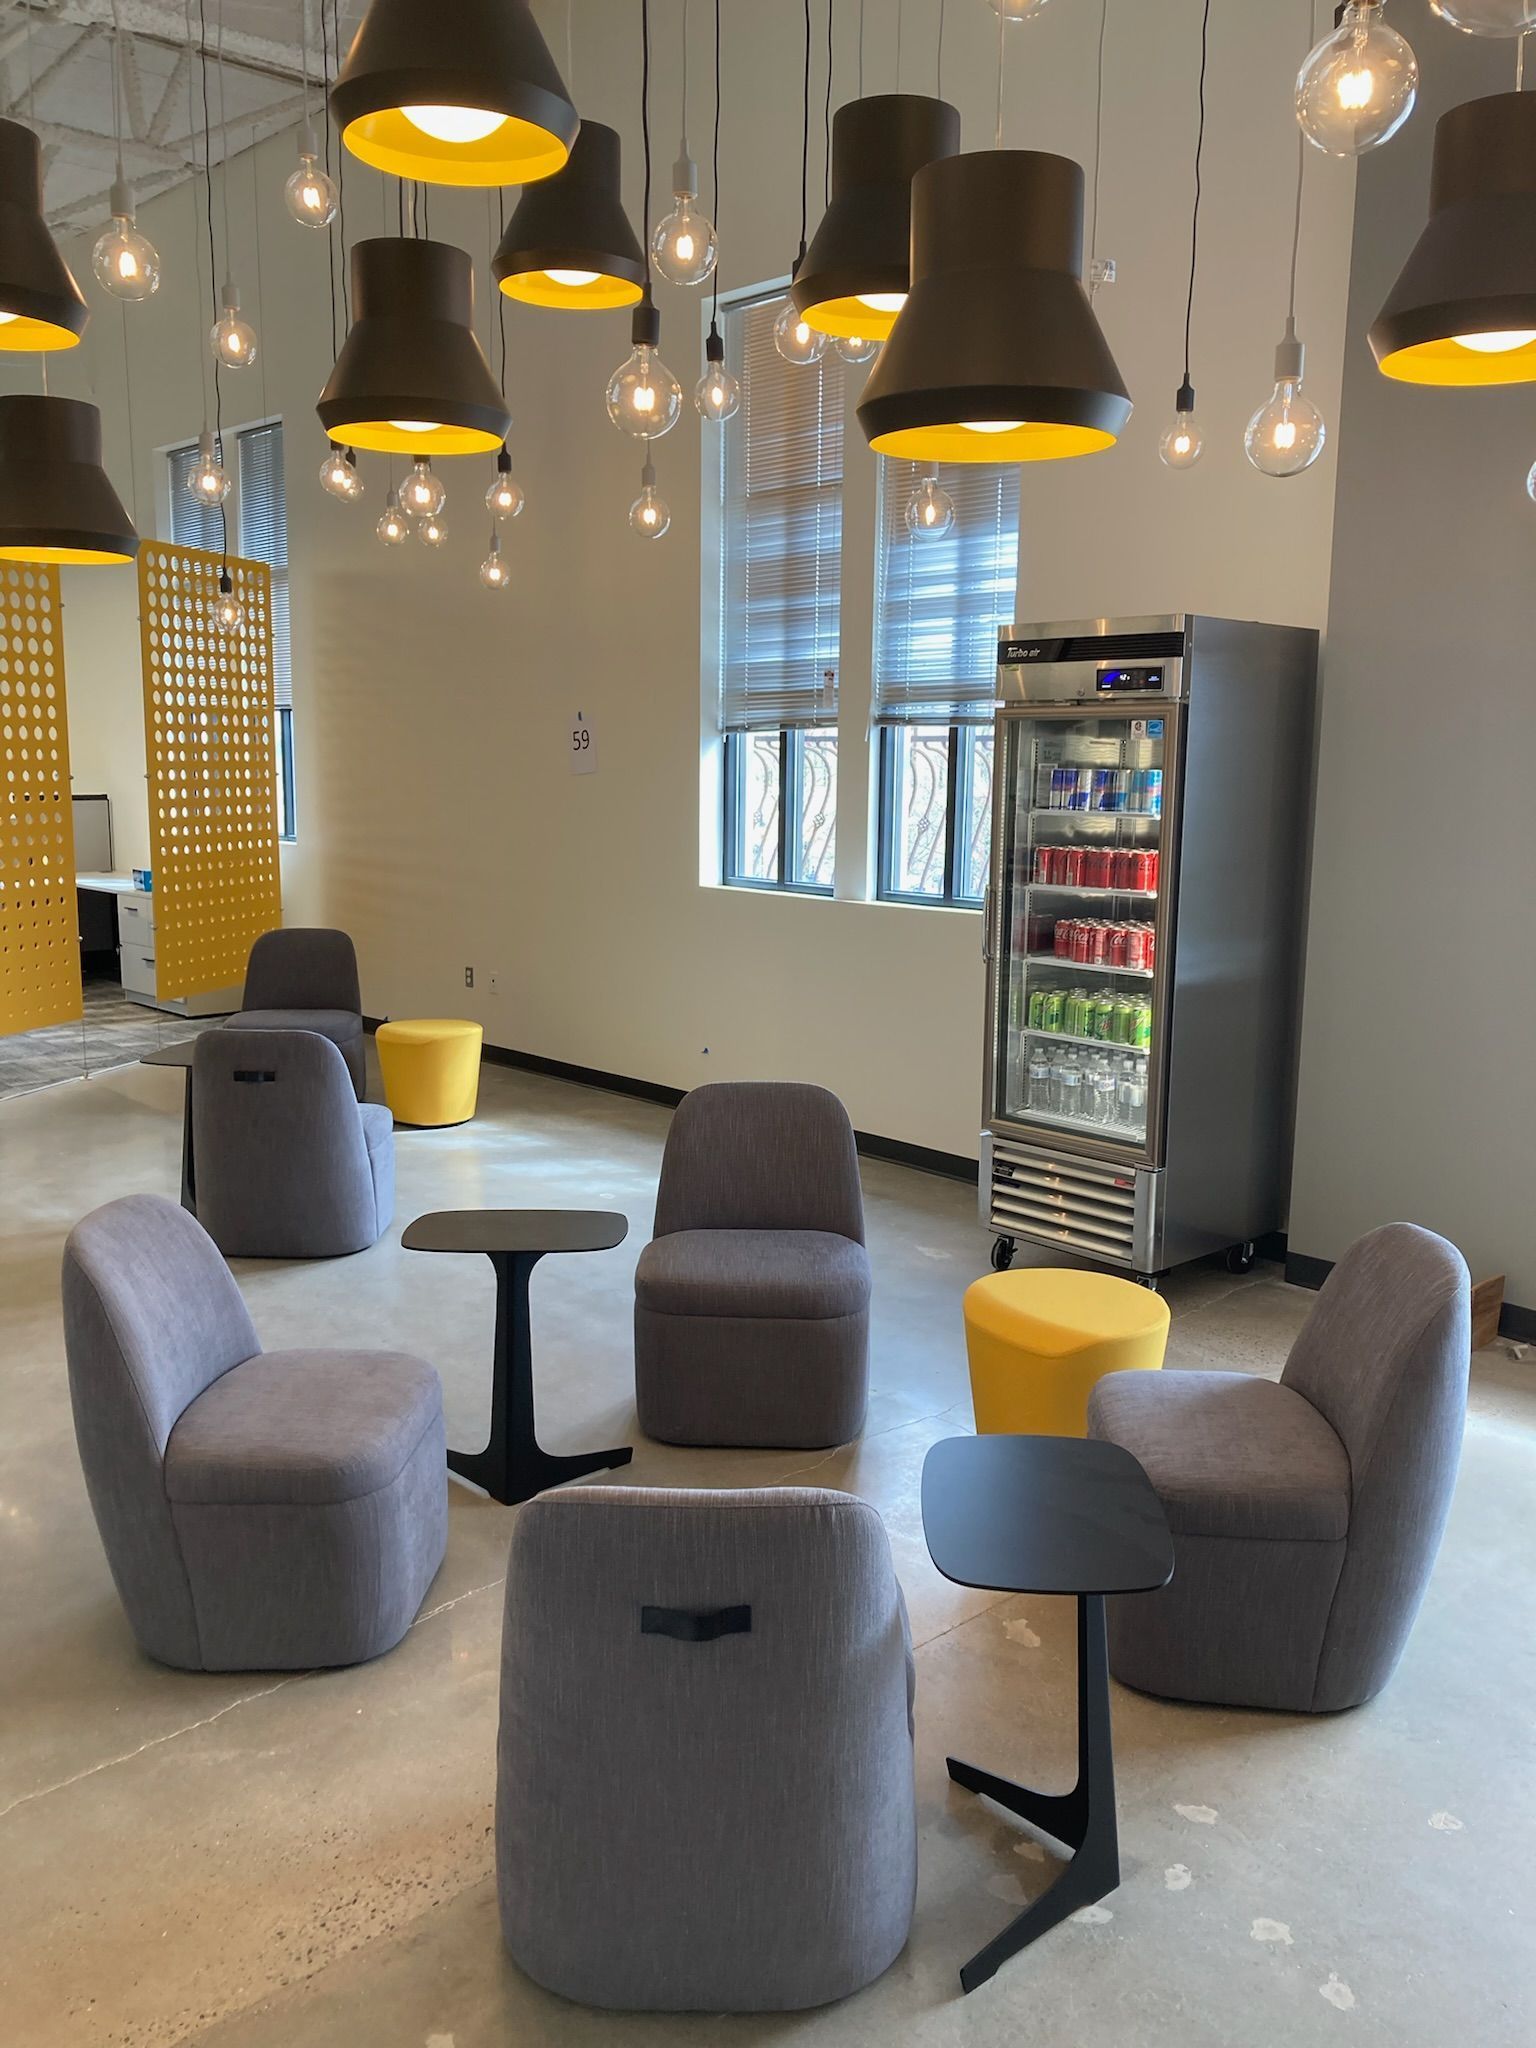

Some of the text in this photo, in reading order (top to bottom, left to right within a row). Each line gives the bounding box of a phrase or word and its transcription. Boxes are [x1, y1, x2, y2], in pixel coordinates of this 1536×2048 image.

[1007, 647, 1040, 658] Turbo air
[572, 729, 590, 751] 59
